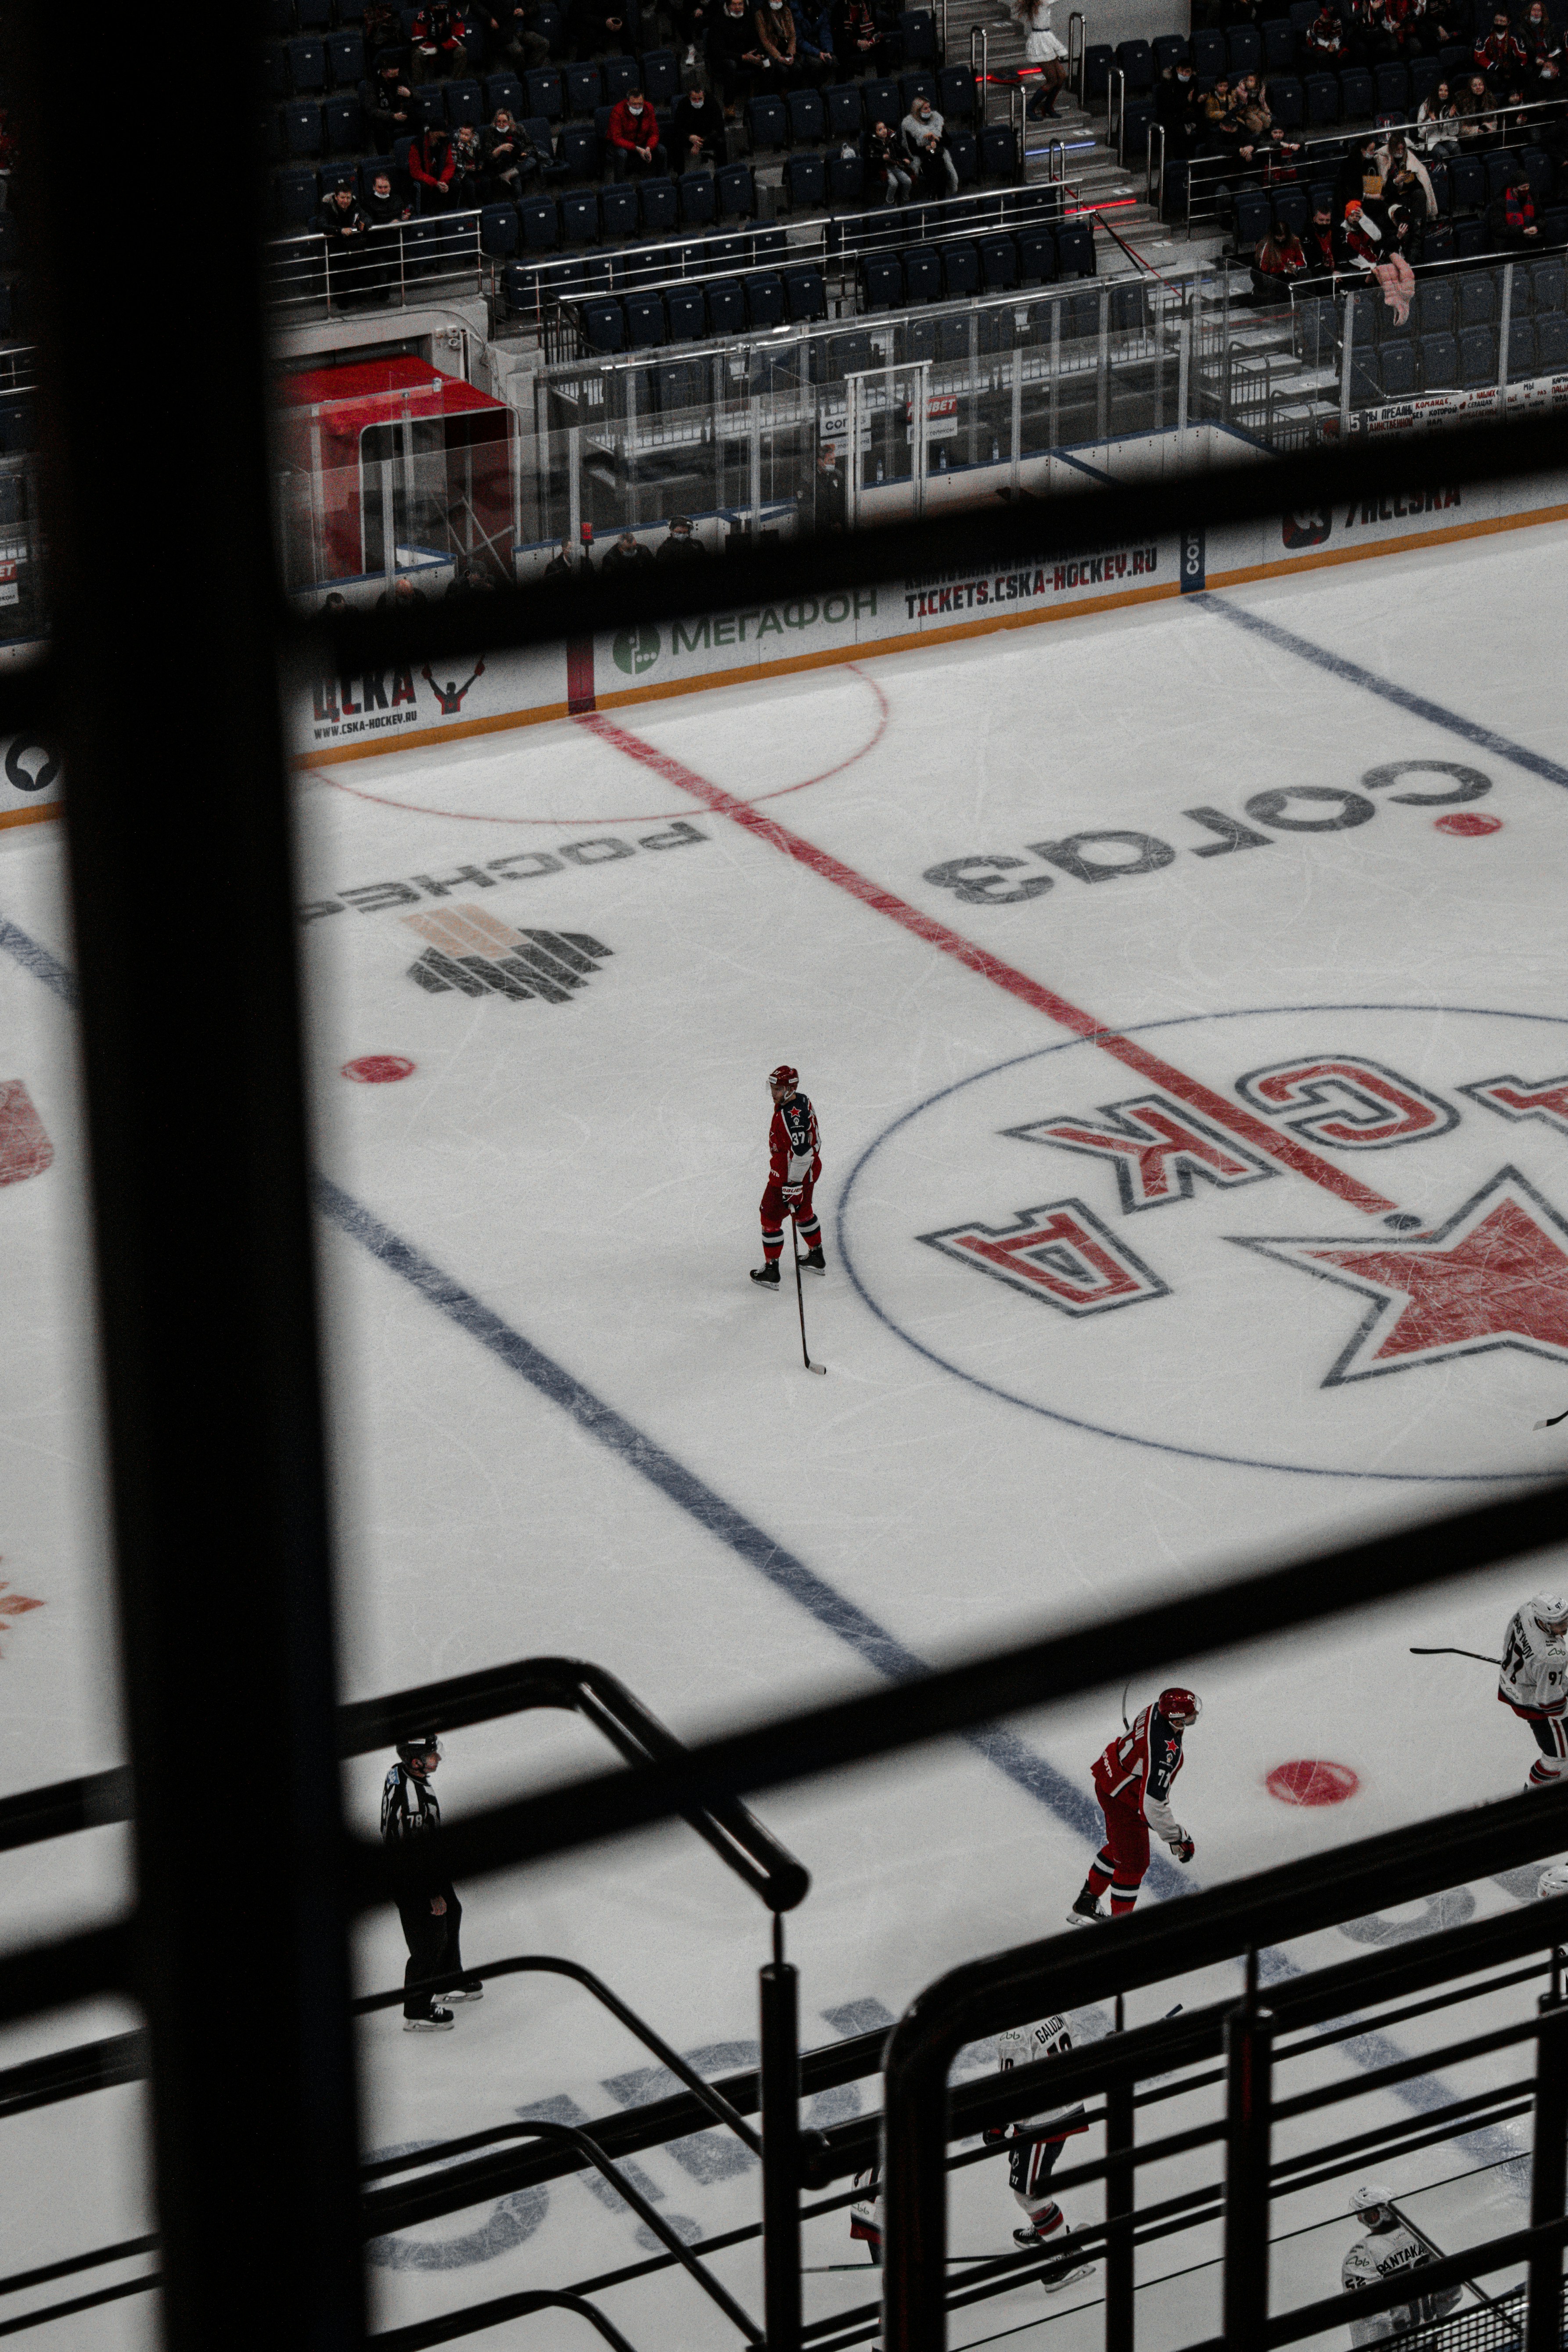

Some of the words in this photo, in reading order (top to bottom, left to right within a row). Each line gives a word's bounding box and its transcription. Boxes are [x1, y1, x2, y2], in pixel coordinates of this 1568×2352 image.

[905, 547, 1157, 619] TICKETS.CSKA-HOCKEY.RU
[314, 710, 417, 740] WWW.CSKA-HOCKEY.RU
[792, 1131, 805, 1146] 37
[1158, 1769, 1171, 1788] 71
